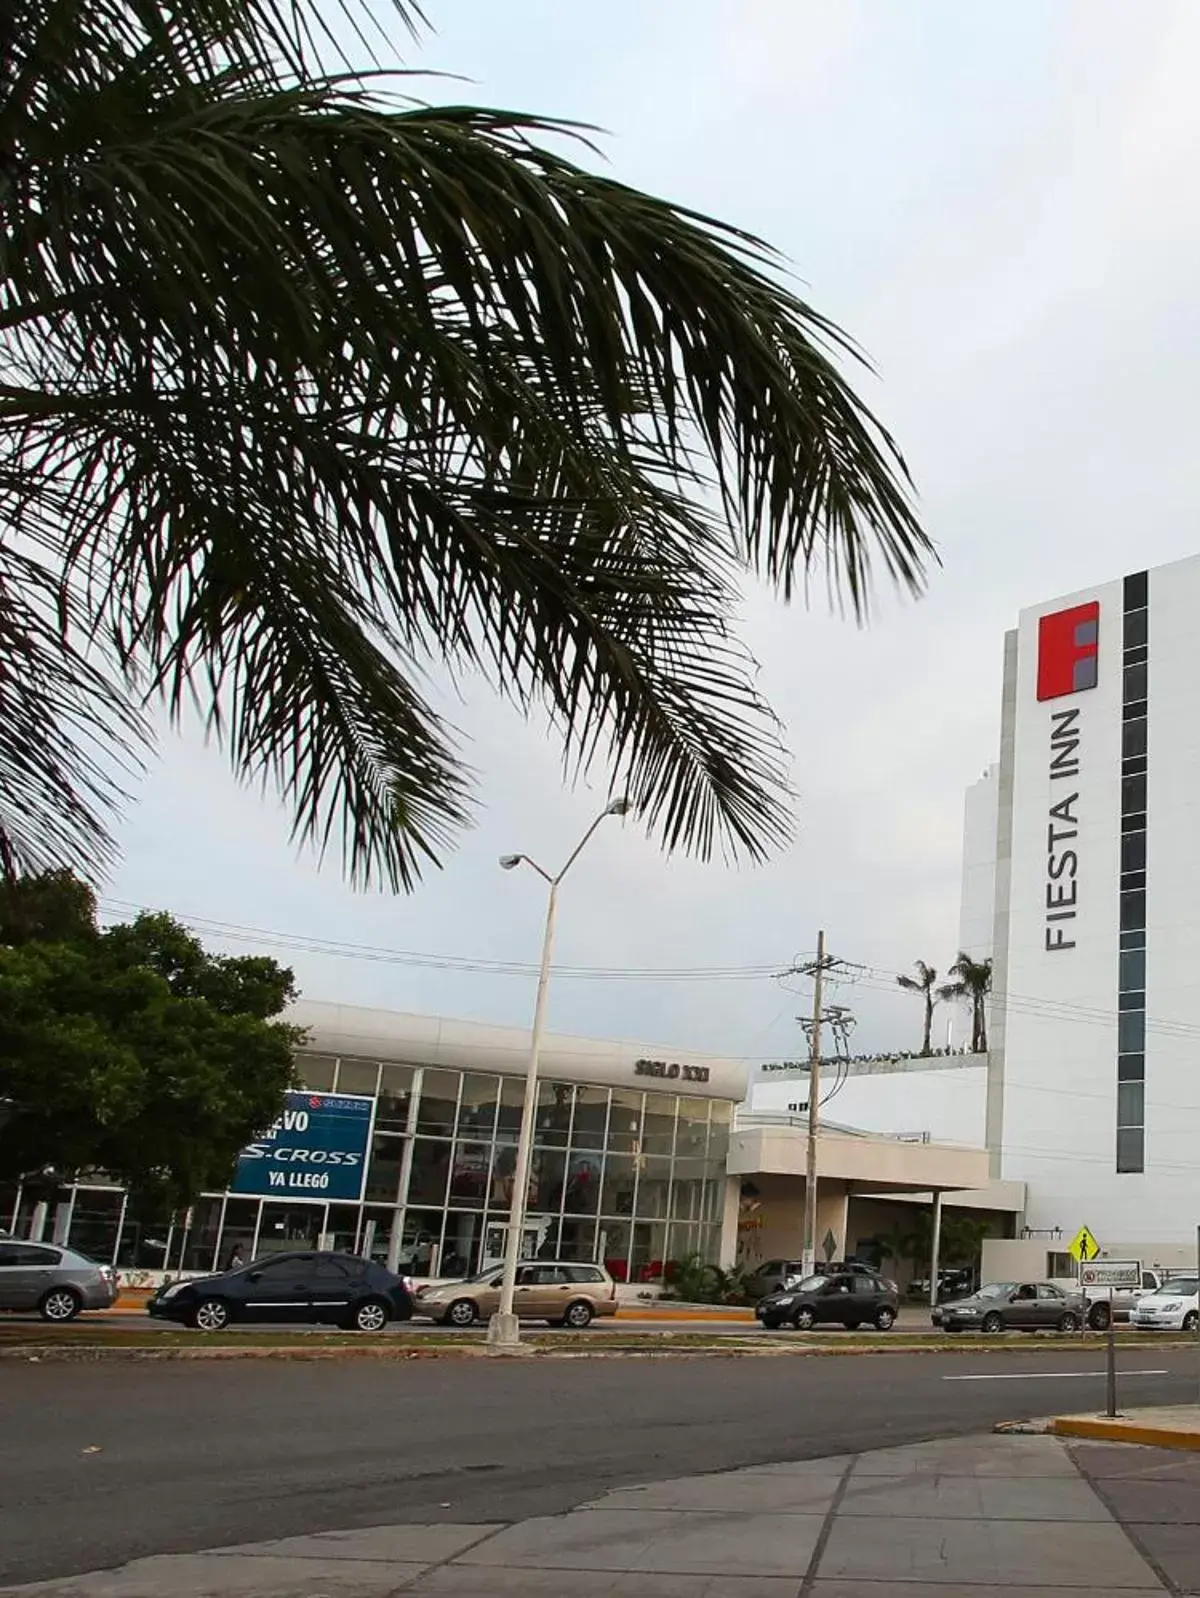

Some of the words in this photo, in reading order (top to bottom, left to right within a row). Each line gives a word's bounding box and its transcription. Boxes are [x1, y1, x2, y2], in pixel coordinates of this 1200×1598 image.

[1049, 708, 1080, 780] INN
[1045, 792, 1079, 951] FIESTA
[240, 1143, 362, 1166] S-CROSS
[268, 1171, 286, 1187] YA
[288, 1172, 330, 1189] LLEGÓ
